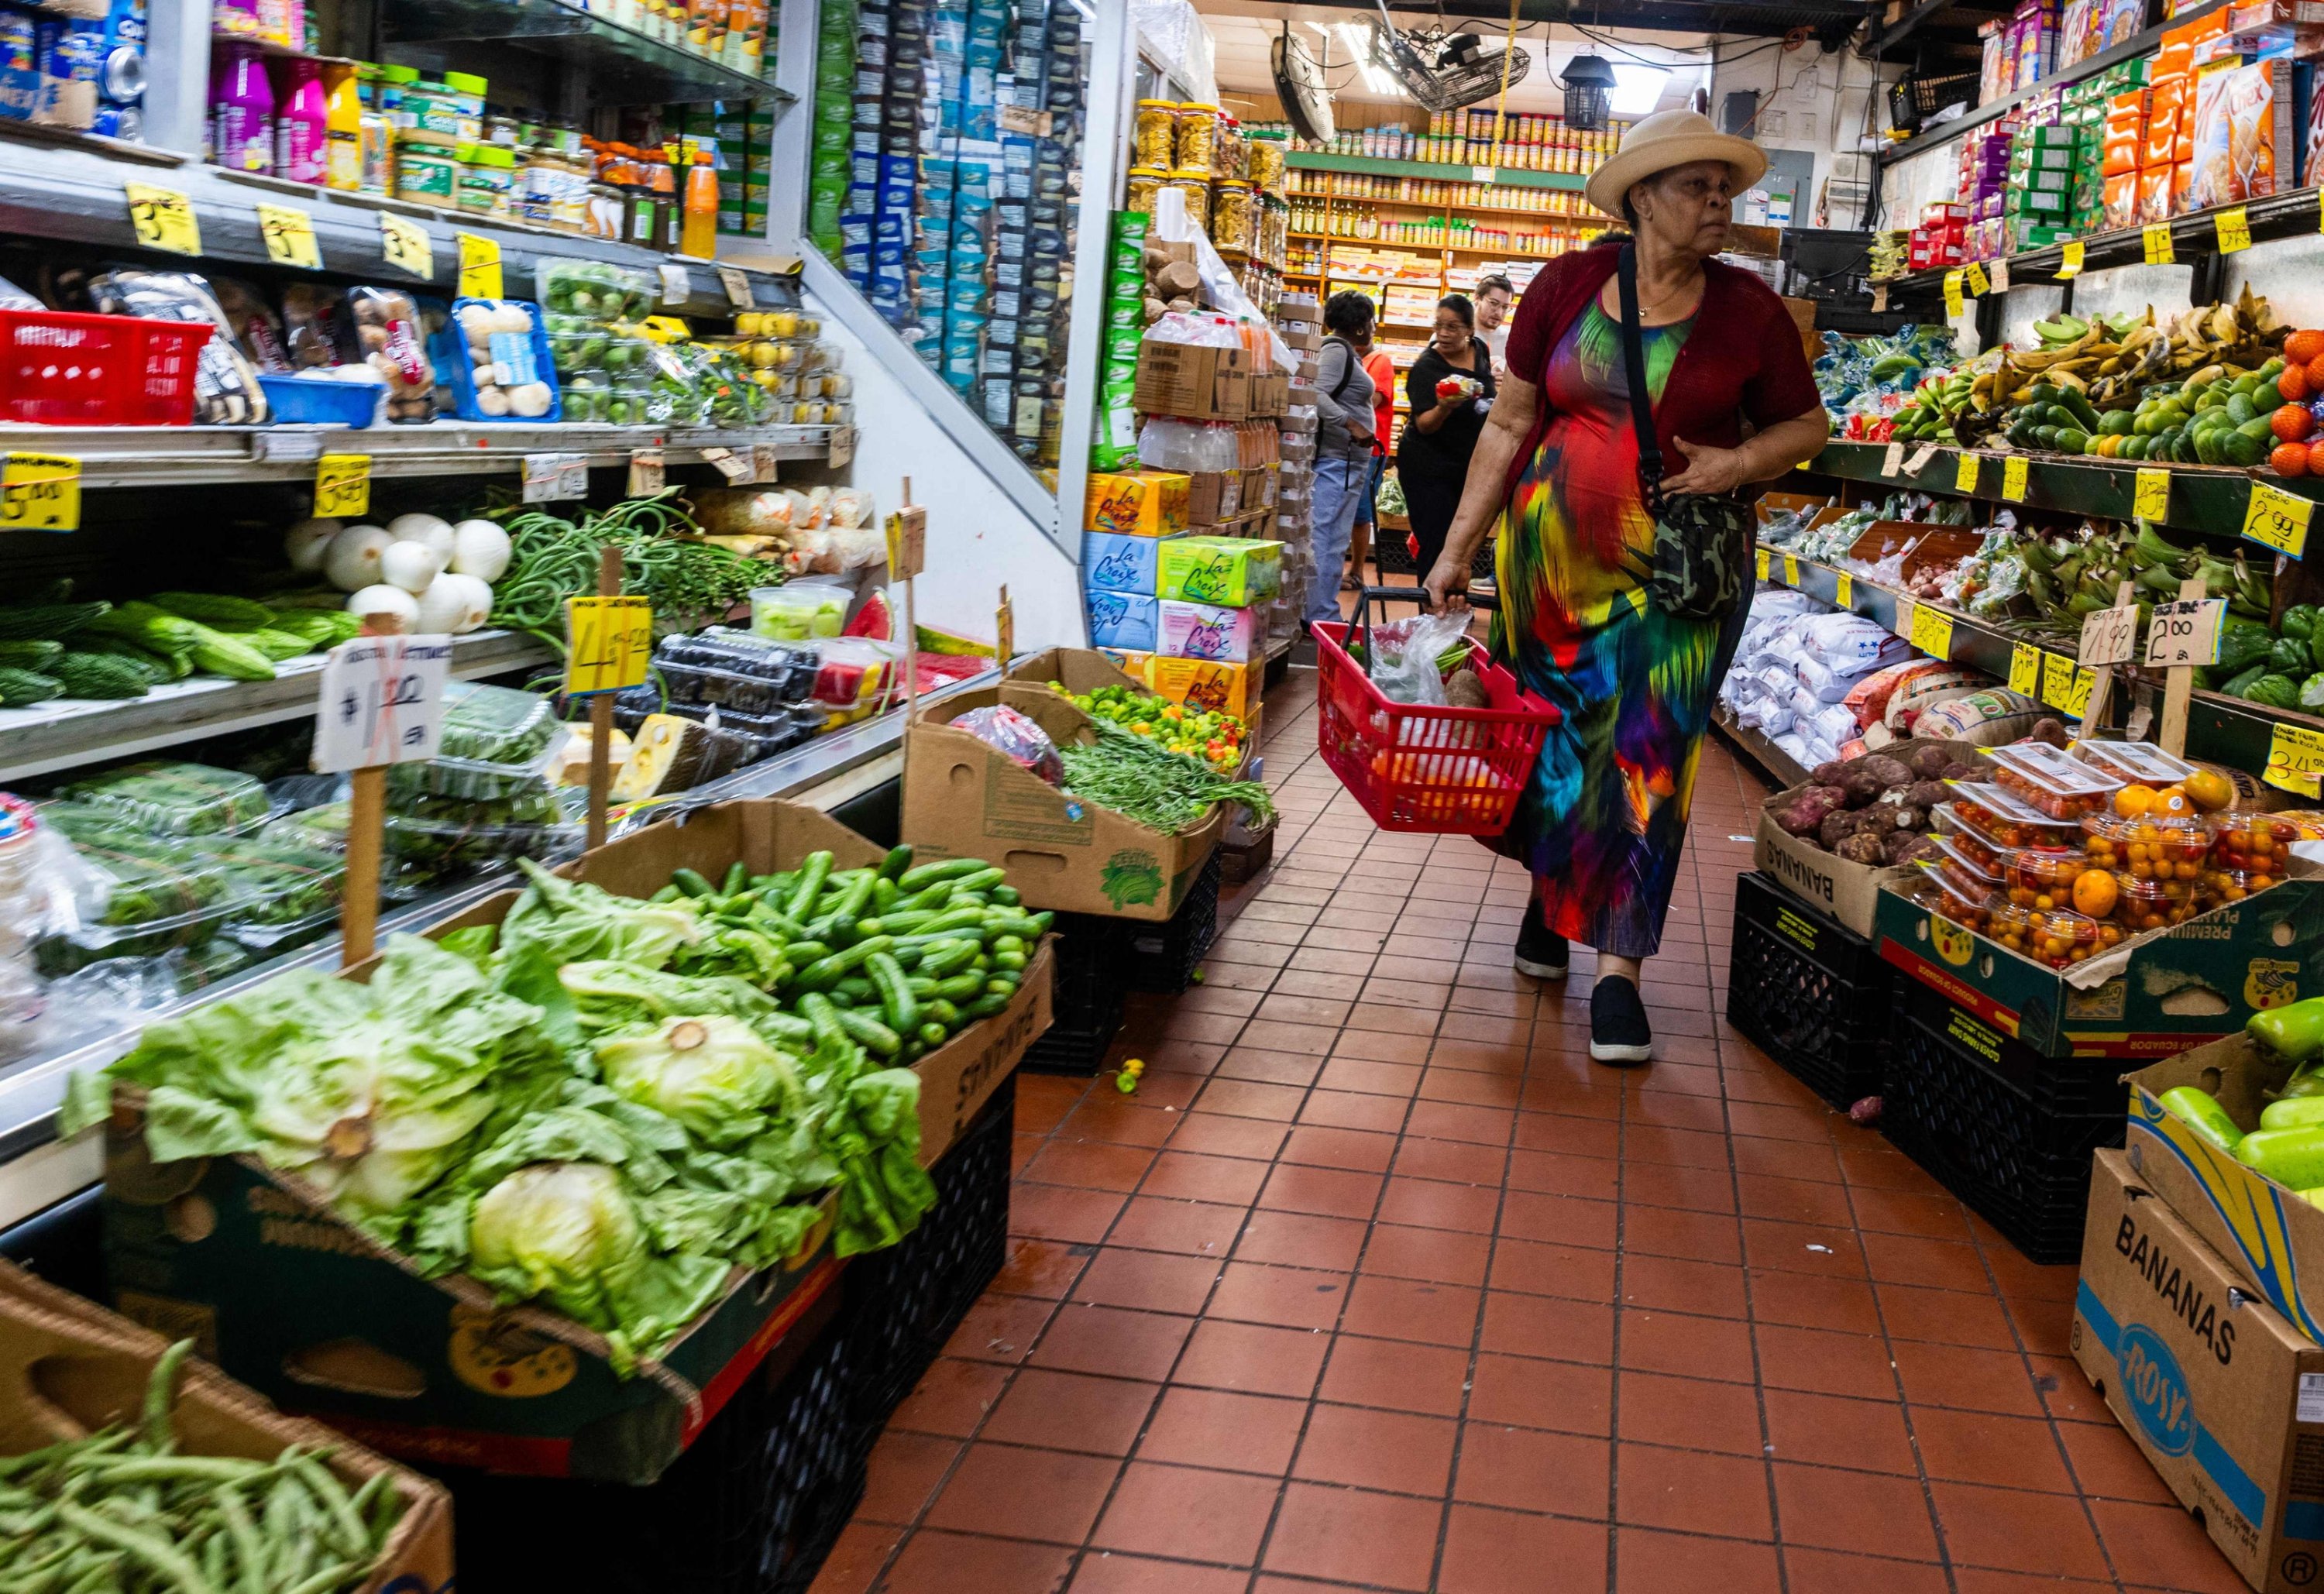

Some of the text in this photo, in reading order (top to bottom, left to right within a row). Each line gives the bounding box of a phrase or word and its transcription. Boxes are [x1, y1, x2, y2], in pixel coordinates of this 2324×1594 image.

[1093, 555, 1140, 586] Croix
[1183, 568, 1229, 600] Croix
[1184, 625, 1232, 658] Croix
[1767, 839, 1834, 904] BANANAS
[2130, 1040, 2178, 1050] ECUADOR
[2116, 1213, 2235, 1366] BANANAS
[2123, 1343, 2187, 1432] ROSY
